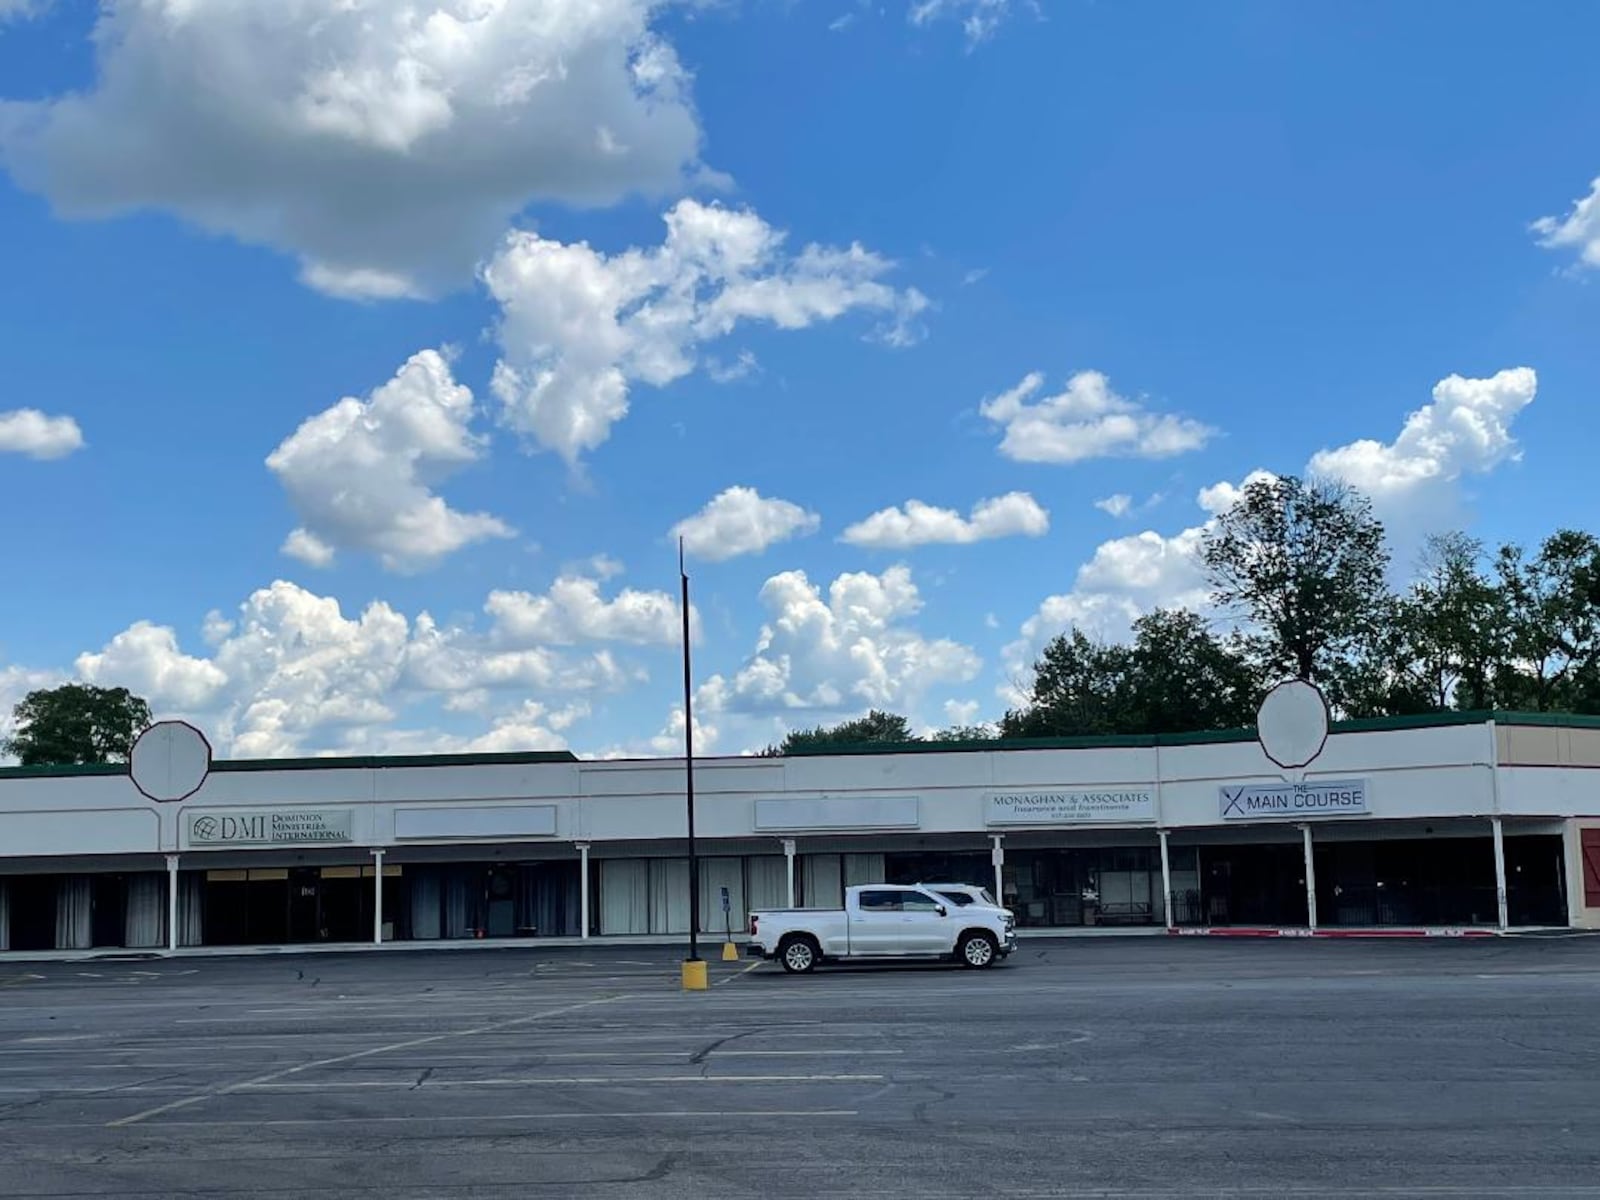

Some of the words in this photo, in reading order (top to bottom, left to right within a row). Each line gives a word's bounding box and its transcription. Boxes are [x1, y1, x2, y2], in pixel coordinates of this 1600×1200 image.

[1293, 785, 1307, 793] THE
[993, 794, 1066, 806] MONAGHAN
[1070, 795, 1078, 804] &
[1082, 793, 1149, 804] ASSOCIATES
[1247, 795, 1288, 809] MAIN
[1294, 791, 1362, 808] COURSE
[221, 816, 266, 839] DMI
